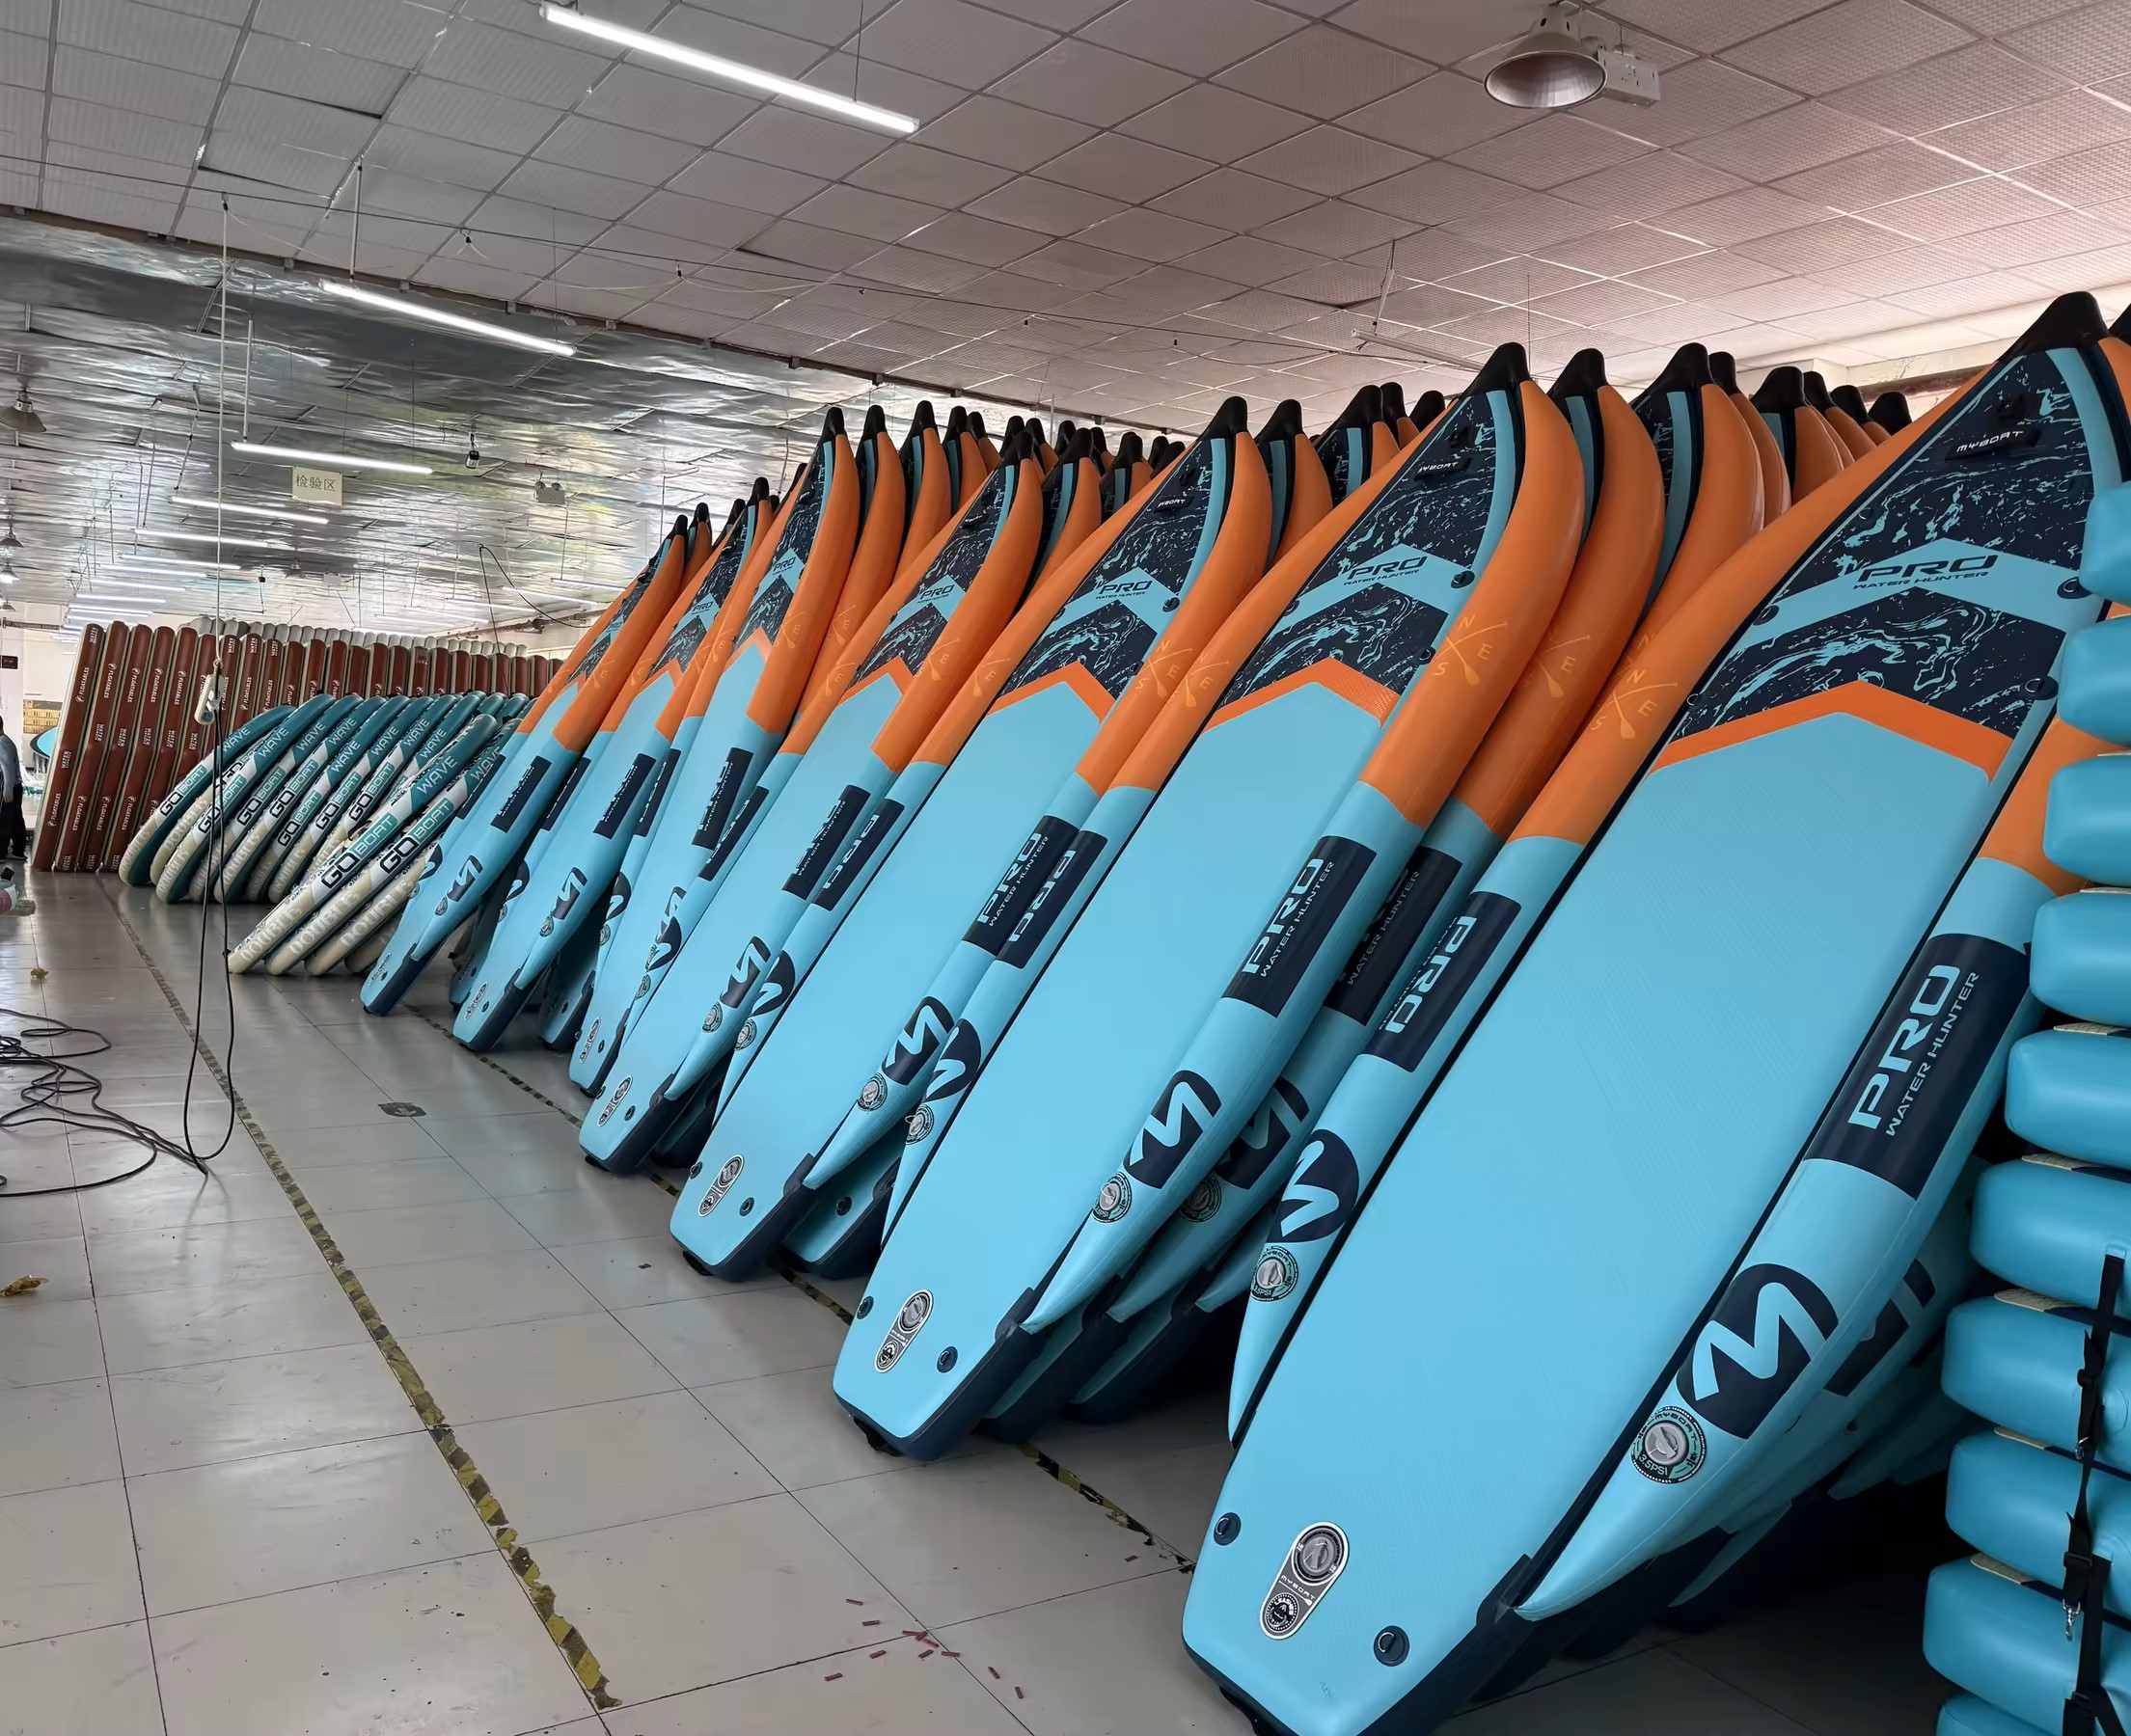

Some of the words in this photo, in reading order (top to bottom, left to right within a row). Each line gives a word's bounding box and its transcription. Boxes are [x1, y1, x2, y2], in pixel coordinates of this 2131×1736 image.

[1956, 431, 2024, 452] MYBOAT
[295, 474, 336, 492] 检验区
[774, 556, 796, 572] PRO
[920, 584, 954, 599] PRO
[1099, 581, 1153, 594] PRO
[1348, 556, 1428, 581] PRO
[1378, 569, 1419, 580] HUNTER
[1853, 580, 1909, 589] WATER
[1914, 572, 1989, 583] HUNTER
[1858, 555, 1999, 583] PRO
[693, 601, 714, 611] PRO
[1478, 642, 1494, 660] E
[1638, 699, 1657, 717] E
[160, 791, 183, 817] GO
[180, 767, 206, 794] BOAT
[223, 726, 251, 752] WAVE
[258, 727, 289, 758] WAVE
[270, 790, 295, 818] GO
[289, 760, 316, 792] BOAT
[328, 718, 357, 746] WAVE
[348, 792, 373, 822] GO
[368, 764, 393, 796] BOAT
[403, 718, 429, 746] WAVE
[420, 728, 447, 759] WAVE
[236, 798, 262, 826] GO
[257, 768, 284, 800] BOAT
[296, 721, 326, 751] WAVE
[278, 820, 301, 847] GO
[294, 791, 319, 823] BOAT
[331, 740, 361, 773] WAVE
[315, 802, 340, 829] GO
[334, 773, 359, 804] BOAT
[370, 725, 398, 755] WAVE
[321, 852, 361, 889] GO
[354, 815, 393, 855] BOAT
[416, 755, 458, 795] WAVE
[288, 891, 359, 956] DOUBLE
[379, 836, 420, 874] GO
[413, 800, 450, 839] BOAT
[977, 833, 1042, 923] PRO
[989, 886, 1017, 927] WATER
[1016, 836, 1049, 883] HUNTER
[1008, 850, 1077, 942] PRO
[1243, 858, 1324, 973] PRO
[1261, 925, 1295, 977] WATER
[1295, 861, 1335, 922] HUNTER
[1347, 934, 1381, 985] WATER
[1380, 871, 1420, 931] HUNTER
[1385, 915, 1477, 1034] PRO
[1847, 964, 1960, 1129] PRO
[1885, 1062, 1930, 1136] WATER
[1926, 972, 1980, 1058] HUNTER
[1654, 1412, 1697, 1441] MYBOAT
[1639, 1453, 1668, 1476] 3.5PSI
[1281, 1574, 1316, 1600] MYBOAT
